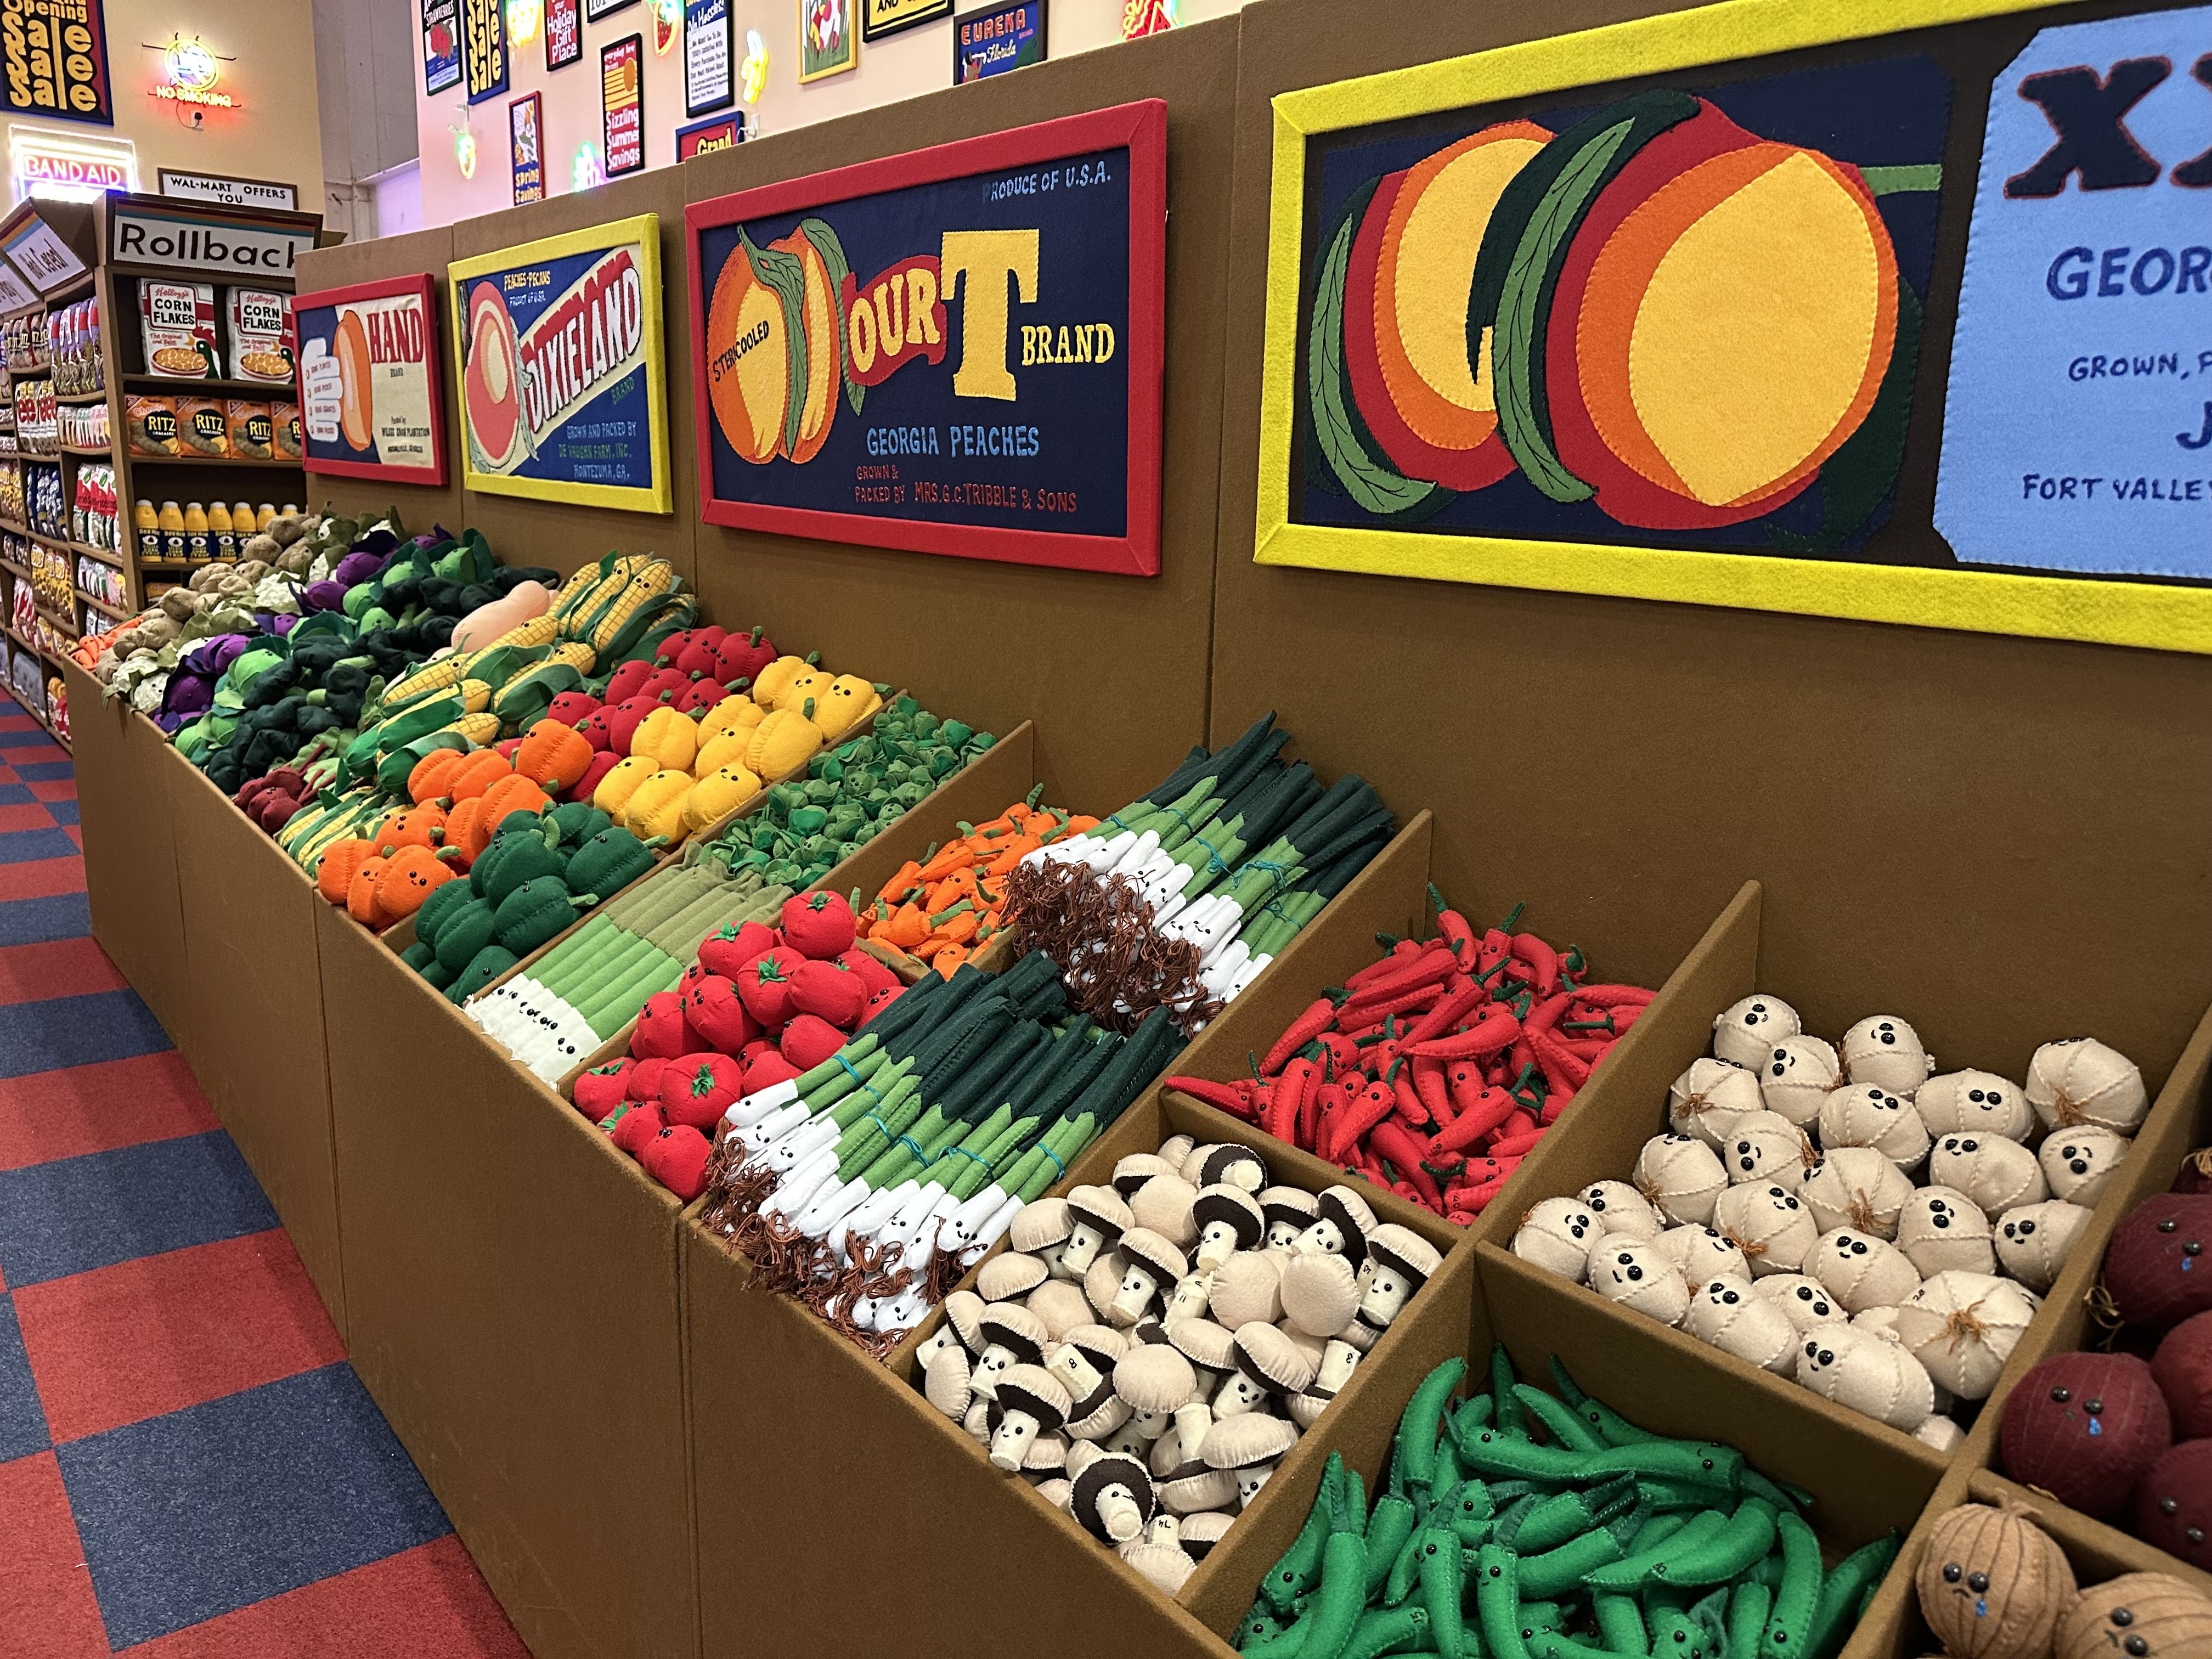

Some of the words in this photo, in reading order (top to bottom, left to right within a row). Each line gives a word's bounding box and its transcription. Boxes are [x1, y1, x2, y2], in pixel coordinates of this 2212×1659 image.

[2, 11, 92, 53] Sale
[547, 8, 577, 35] Holiday
[961, 9, 1025, 46] EUREKA
[469, 13, 500, 64] Sale
[555, 25, 572, 47] Gift
[5, 44, 93, 82] Sale
[551, 42, 577, 64] Place
[986, 39, 1016, 63] Florida
[470, 48, 501, 95] Sale
[9, 76, 97, 112] Sale
[156, 84, 176, 99] NO
[176, 88, 232, 109] SMOKING
[606, 108, 640, 131] Sizzling
[24, 154, 83, 182] BAND
[86, 165, 122, 187] AID
[607, 147, 640, 171] Savings
[171, 177, 232, 193] WAL-MART
[243, 185, 286, 200] OFFERS
[1041, 170, 1059, 191] OF
[1066, 161, 1111, 188] U.S.A.
[217, 193, 243, 204] YOU
[2046, 246, 2212, 301] GEOR
[154, 298, 192, 312] CORN
[155, 287, 189, 300] Kellogg's
[245, 294, 276, 305] Kellogg's
[153, 311, 195, 325] FLAKES
[242, 317, 281, 331] FLAKES
[244, 304, 280, 319] CORN
[849, 268, 940, 373] OUR
[941, 229, 1040, 402] T
[366, 308, 425, 364] HAND
[525, 263, 642, 434] DIXIELAND
[1021, 323, 1115, 366] BRAND
[713, 320, 769, 382] STERICOOLED
[2068, 352, 2190, 382] GROWN,
[611, 376, 635, 405] BRAND
[148, 416, 176, 432] RITZ
[195, 414, 224, 432] RITZ
[567, 425, 587, 439] GROWN
[588, 423, 601, 439] AND
[602, 421, 627, 438] PACKED
[627, 421, 637, 437] BY
[867, 426, 939, 457] GEORGIA
[950, 425, 1040, 458] PEACHES
[856, 464, 890, 481] GROWN
[891, 464, 899, 480] &
[854, 486, 890, 504] PACKED
[894, 484, 905, 504] BY
[1021, 488, 1032, 510] &
[1036, 488, 1077, 514] SONS
[2023, 473, 2103, 500] FORT
[2112, 477, 2212, 501] VALLE
